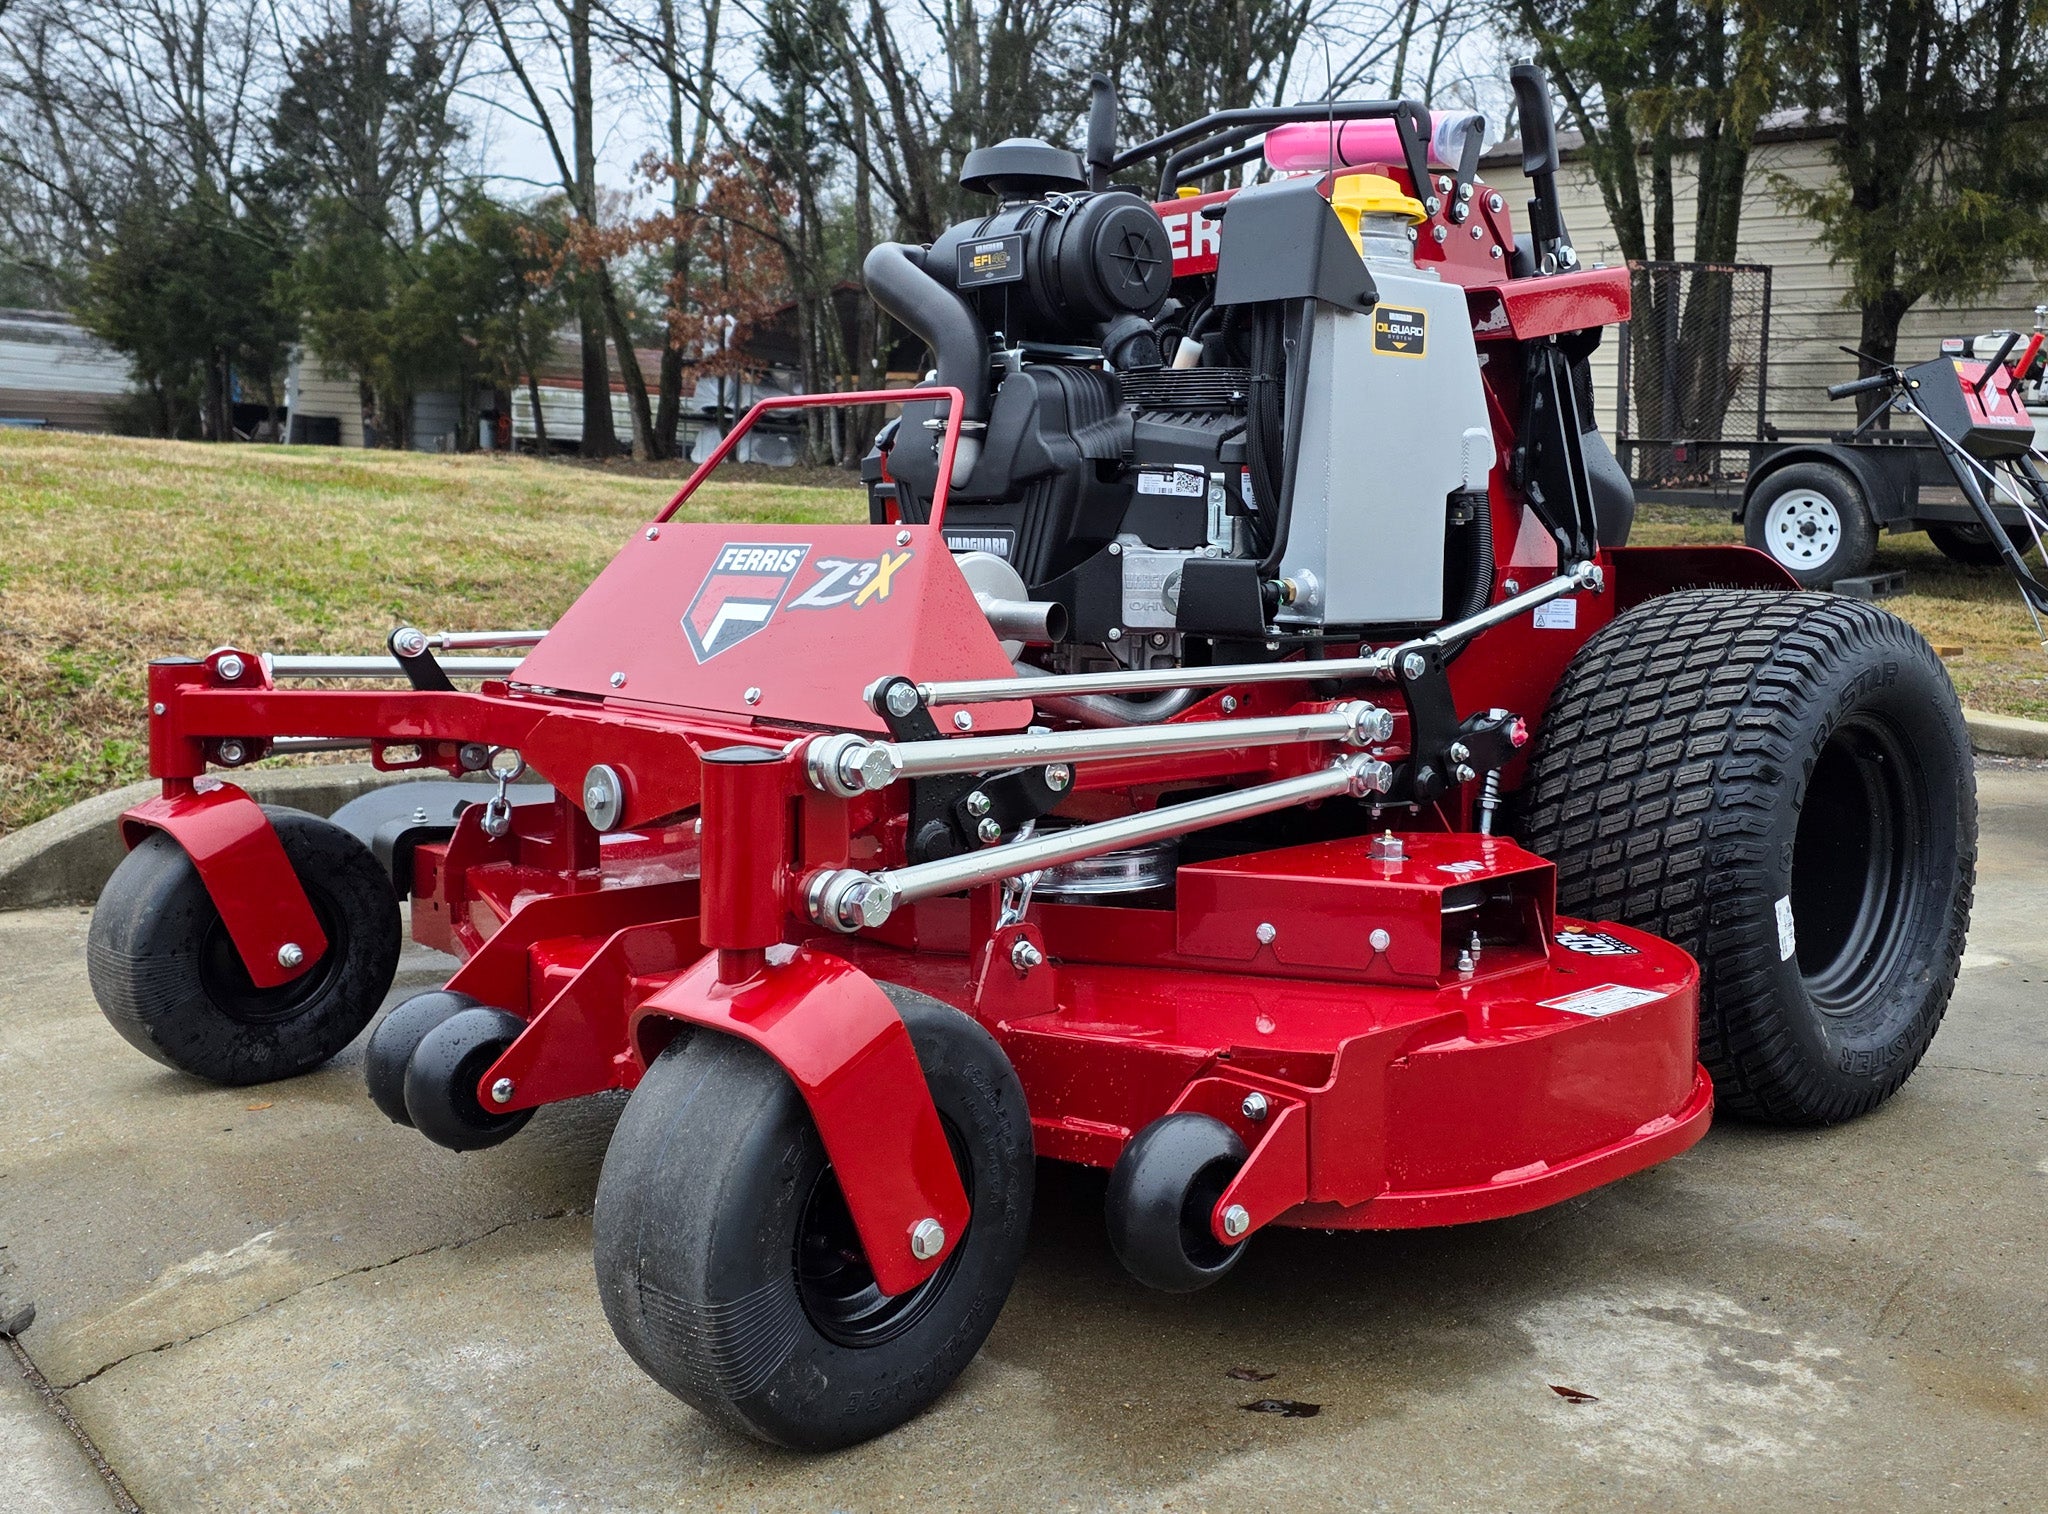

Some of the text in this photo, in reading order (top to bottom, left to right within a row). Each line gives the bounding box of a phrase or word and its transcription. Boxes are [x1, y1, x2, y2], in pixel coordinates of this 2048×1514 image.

[1162, 210, 1222, 260] ER
[717, 548, 801, 573] FERRIS
[947, 536, 1008, 556] VANGUARD
[786, 552, 912, 608] Z3X
